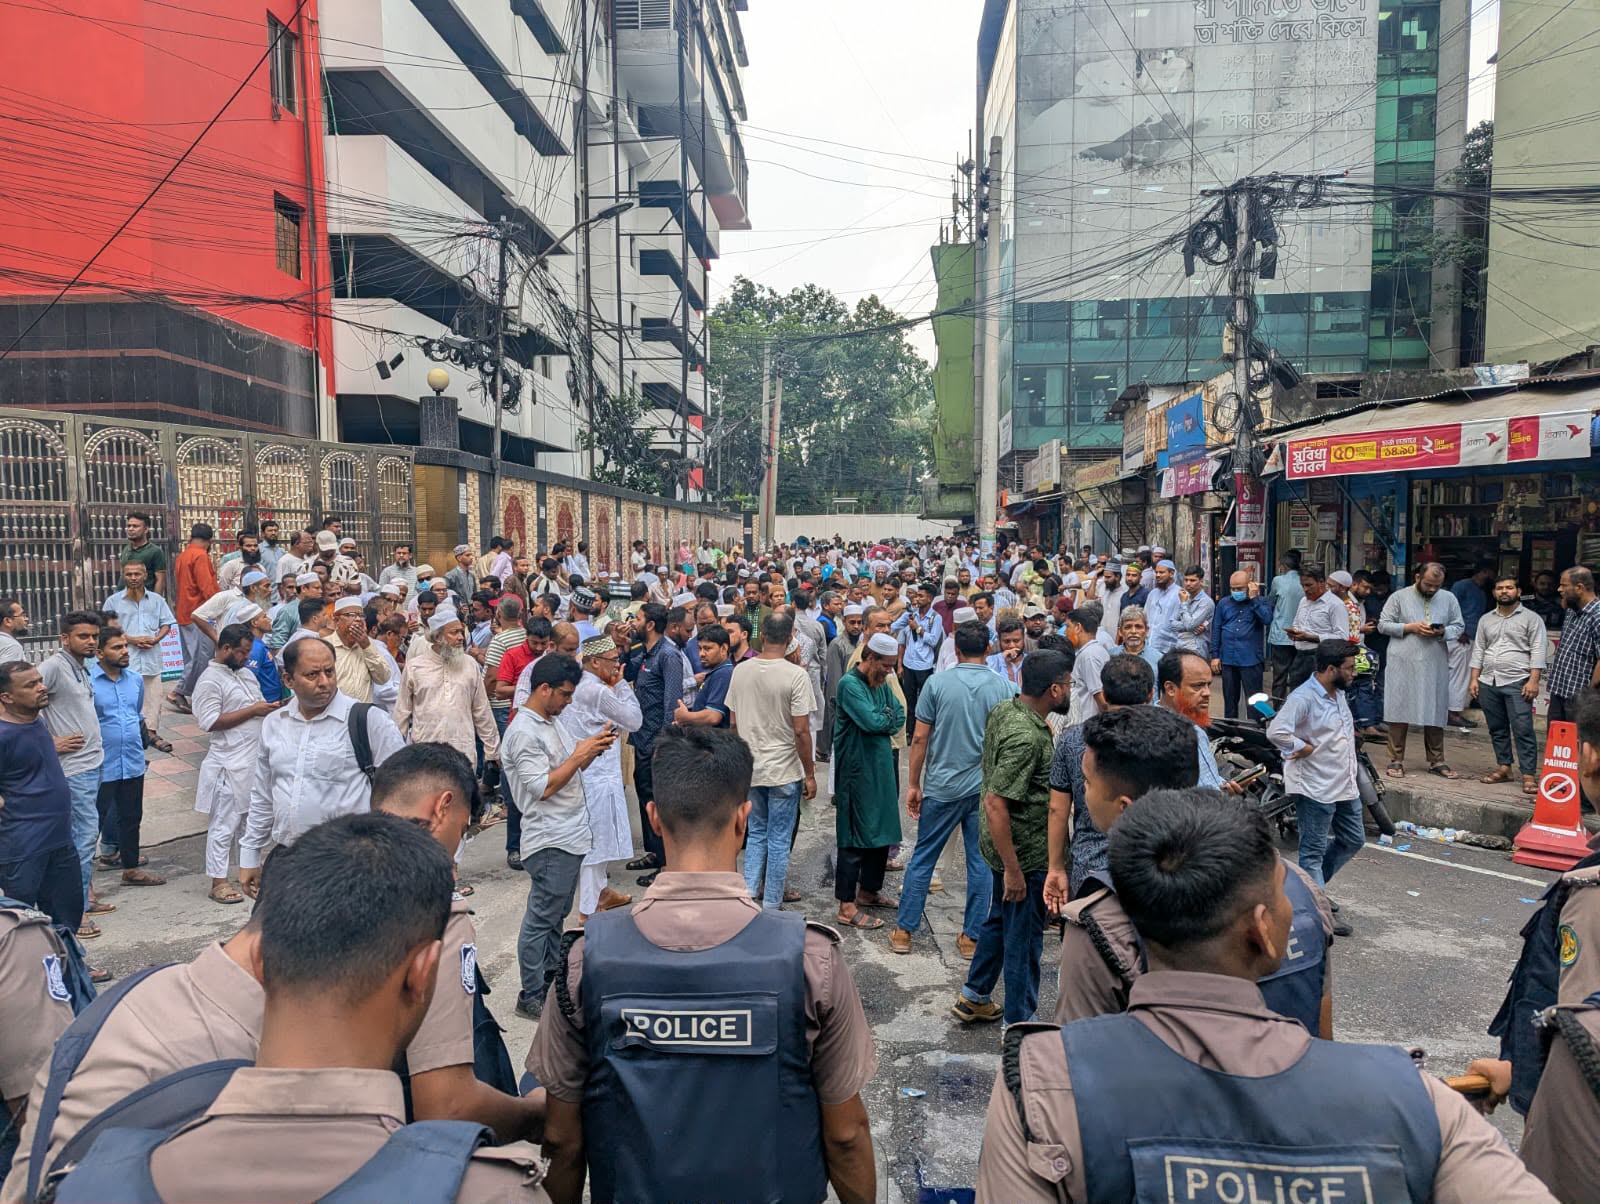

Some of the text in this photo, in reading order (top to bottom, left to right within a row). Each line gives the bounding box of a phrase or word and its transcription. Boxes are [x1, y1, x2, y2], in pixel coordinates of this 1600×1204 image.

[1194, 21, 1219, 43] তা
[1221, 17, 1265, 42] শক্তি
[1269, 19, 1313, 41] দেবে
[1384, 445, 1415, 456] ১৪.৯০
[1422, 435, 1434, 454] ২
[1293, 447, 1328, 463] সুবিধা
[1333, 446, 1356, 460] ৫০
[1292, 460, 1327, 473] ডাবল
[1553, 745, 1572, 759] NO
[1544, 758, 1578, 770] PARKING
[633, 1015, 737, 1039] POLICE
[1185, 1167, 1346, 1204] POLICE
